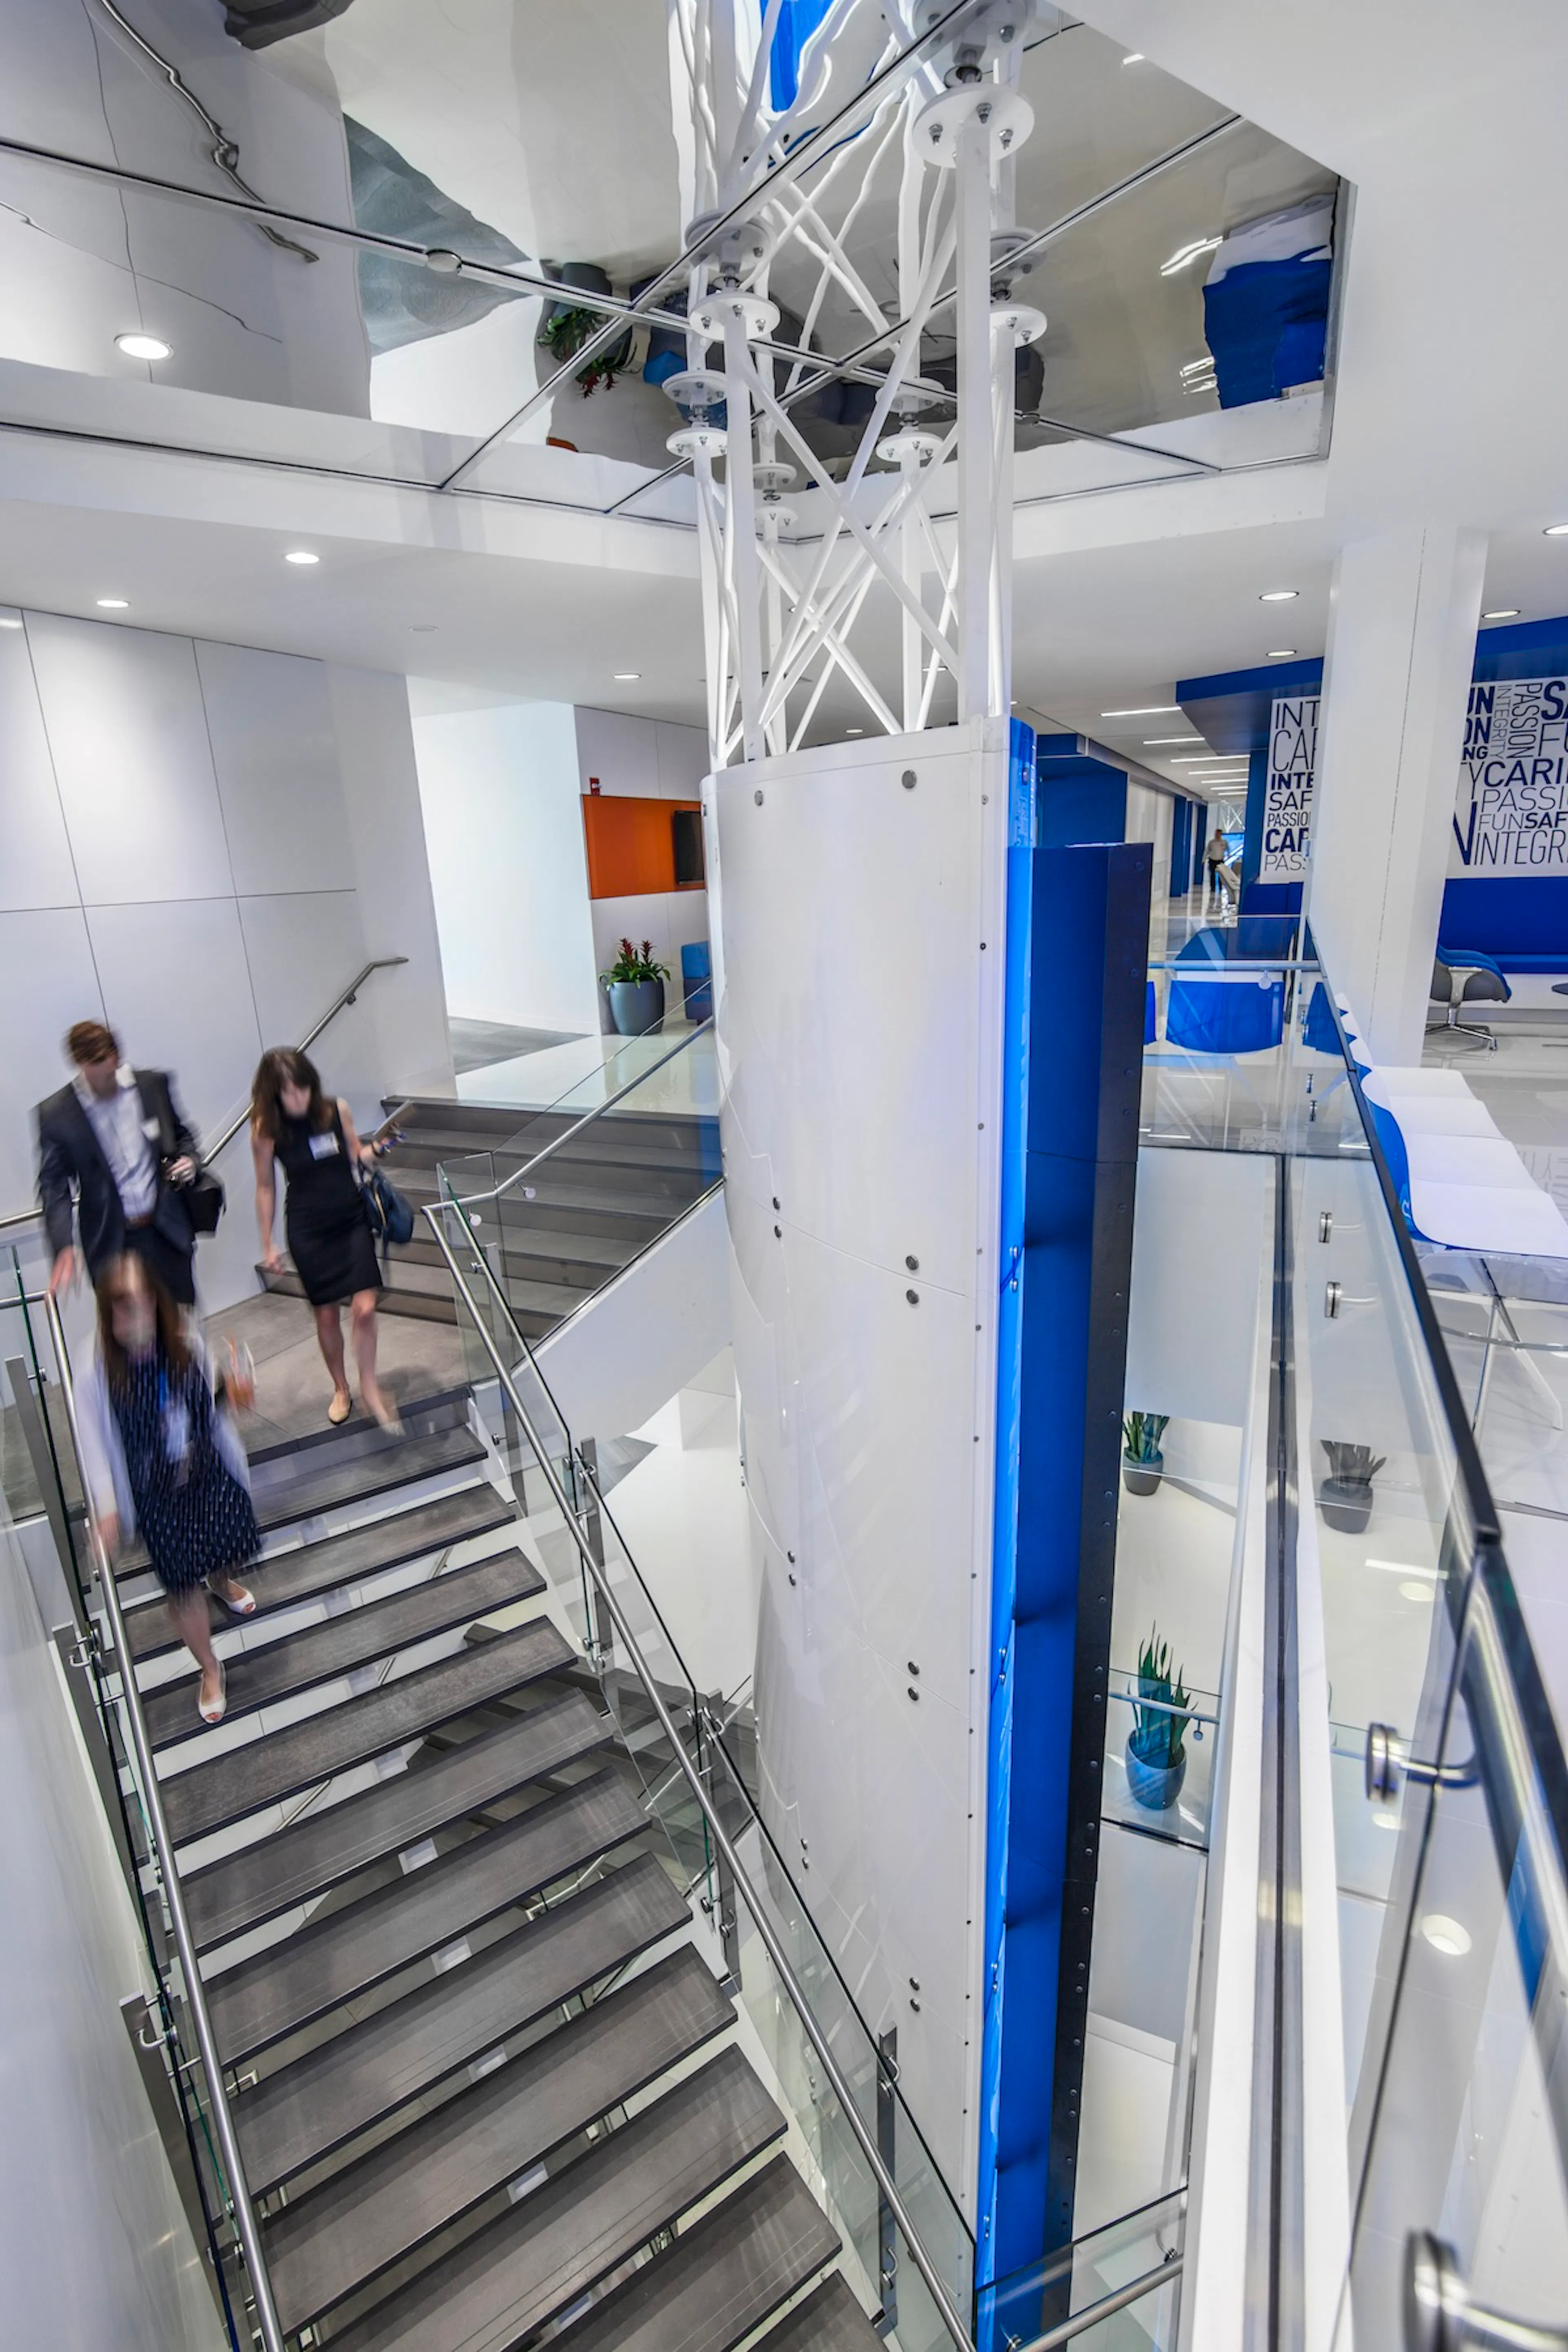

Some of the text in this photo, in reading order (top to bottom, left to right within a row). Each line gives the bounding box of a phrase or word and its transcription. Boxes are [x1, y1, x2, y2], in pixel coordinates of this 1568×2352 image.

[1541, 681, 1568, 720] S
[1490, 684, 1513, 760] INTEGRITY
[1507, 683, 1543, 758] PASSION
[1484, 757, 1568, 787] CARI
[1269, 791, 1312, 811] SAF
[1481, 786, 1568, 813] PASSI
[1267, 811, 1311, 827] PASSIO
[1265, 853, 1306, 871] PAS
[1474, 830, 1568, 865] INTEGR
